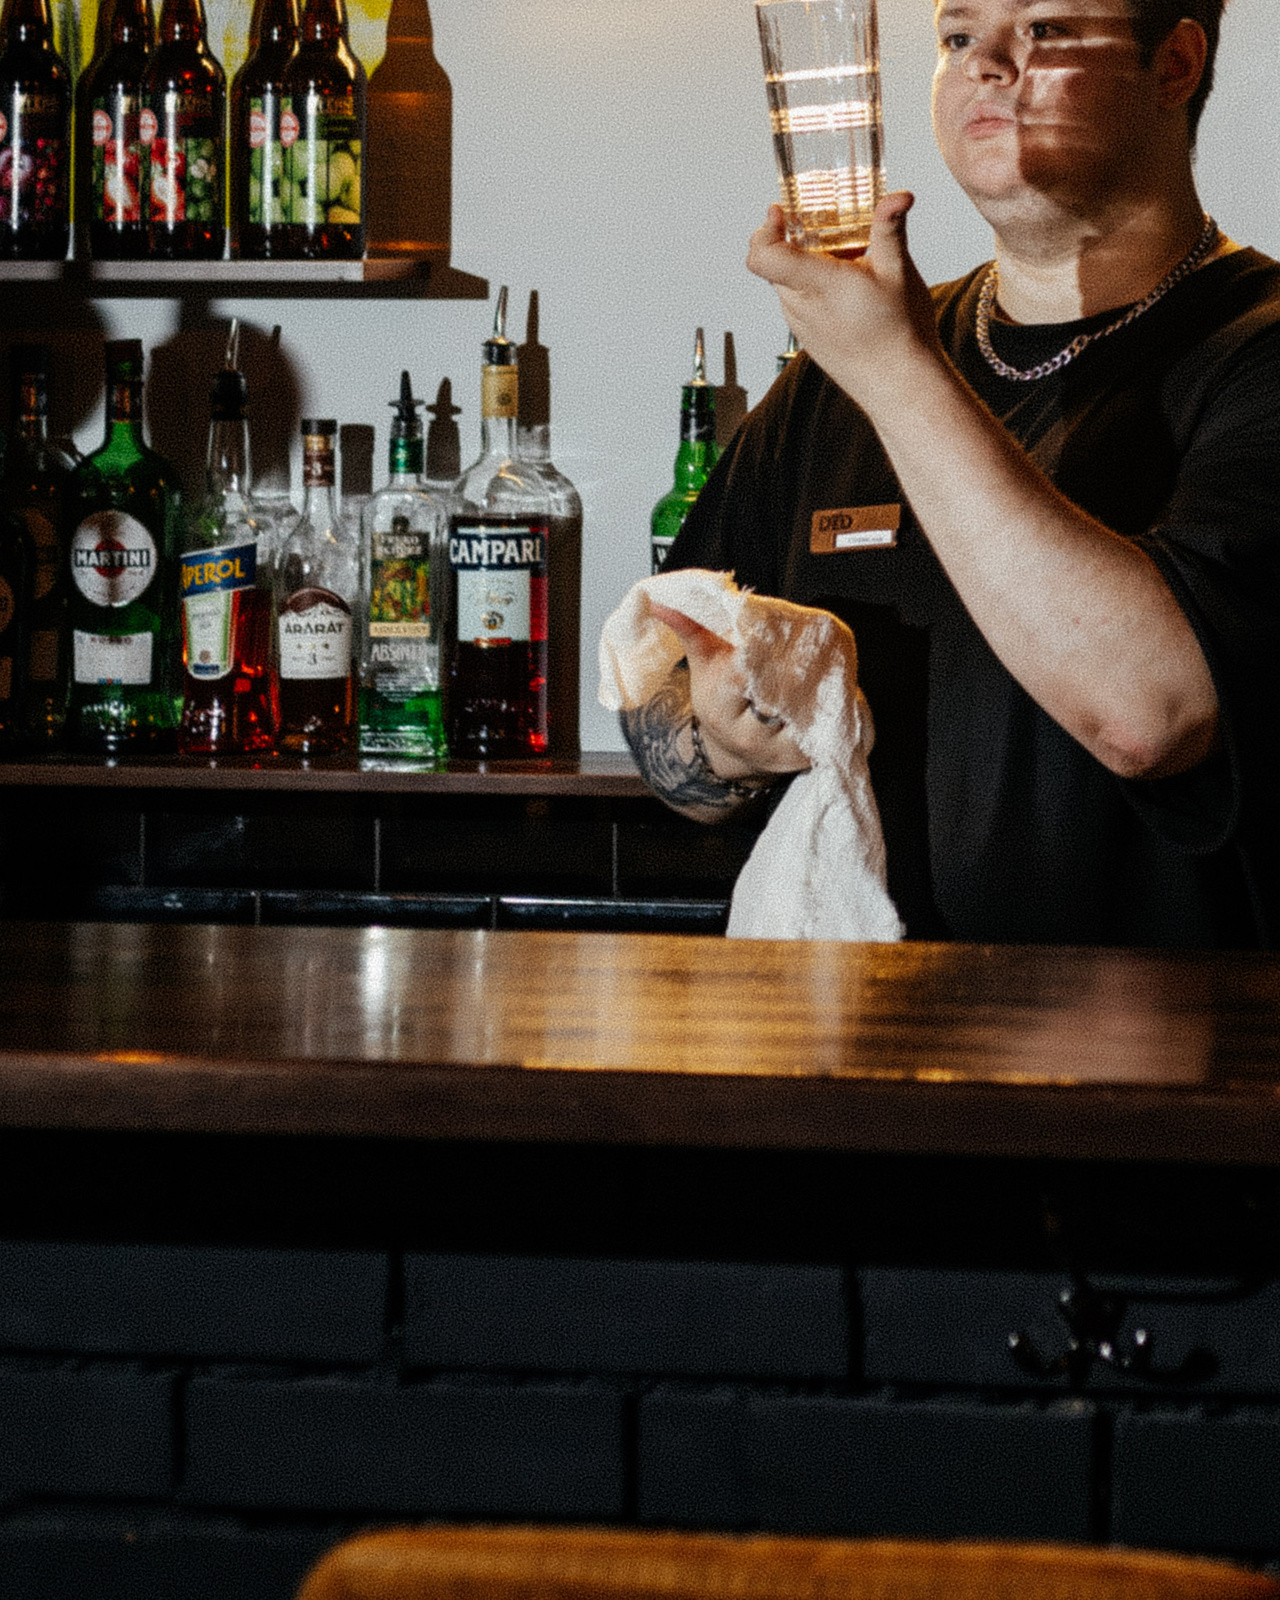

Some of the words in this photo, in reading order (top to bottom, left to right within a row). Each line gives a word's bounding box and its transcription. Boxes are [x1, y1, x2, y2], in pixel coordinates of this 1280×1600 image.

[818, 514, 853, 532] DED
[75, 549, 150, 568] MARTINI
[450, 538, 541, 565] CAMPARI
[285, 621, 345, 635] ARARAT
